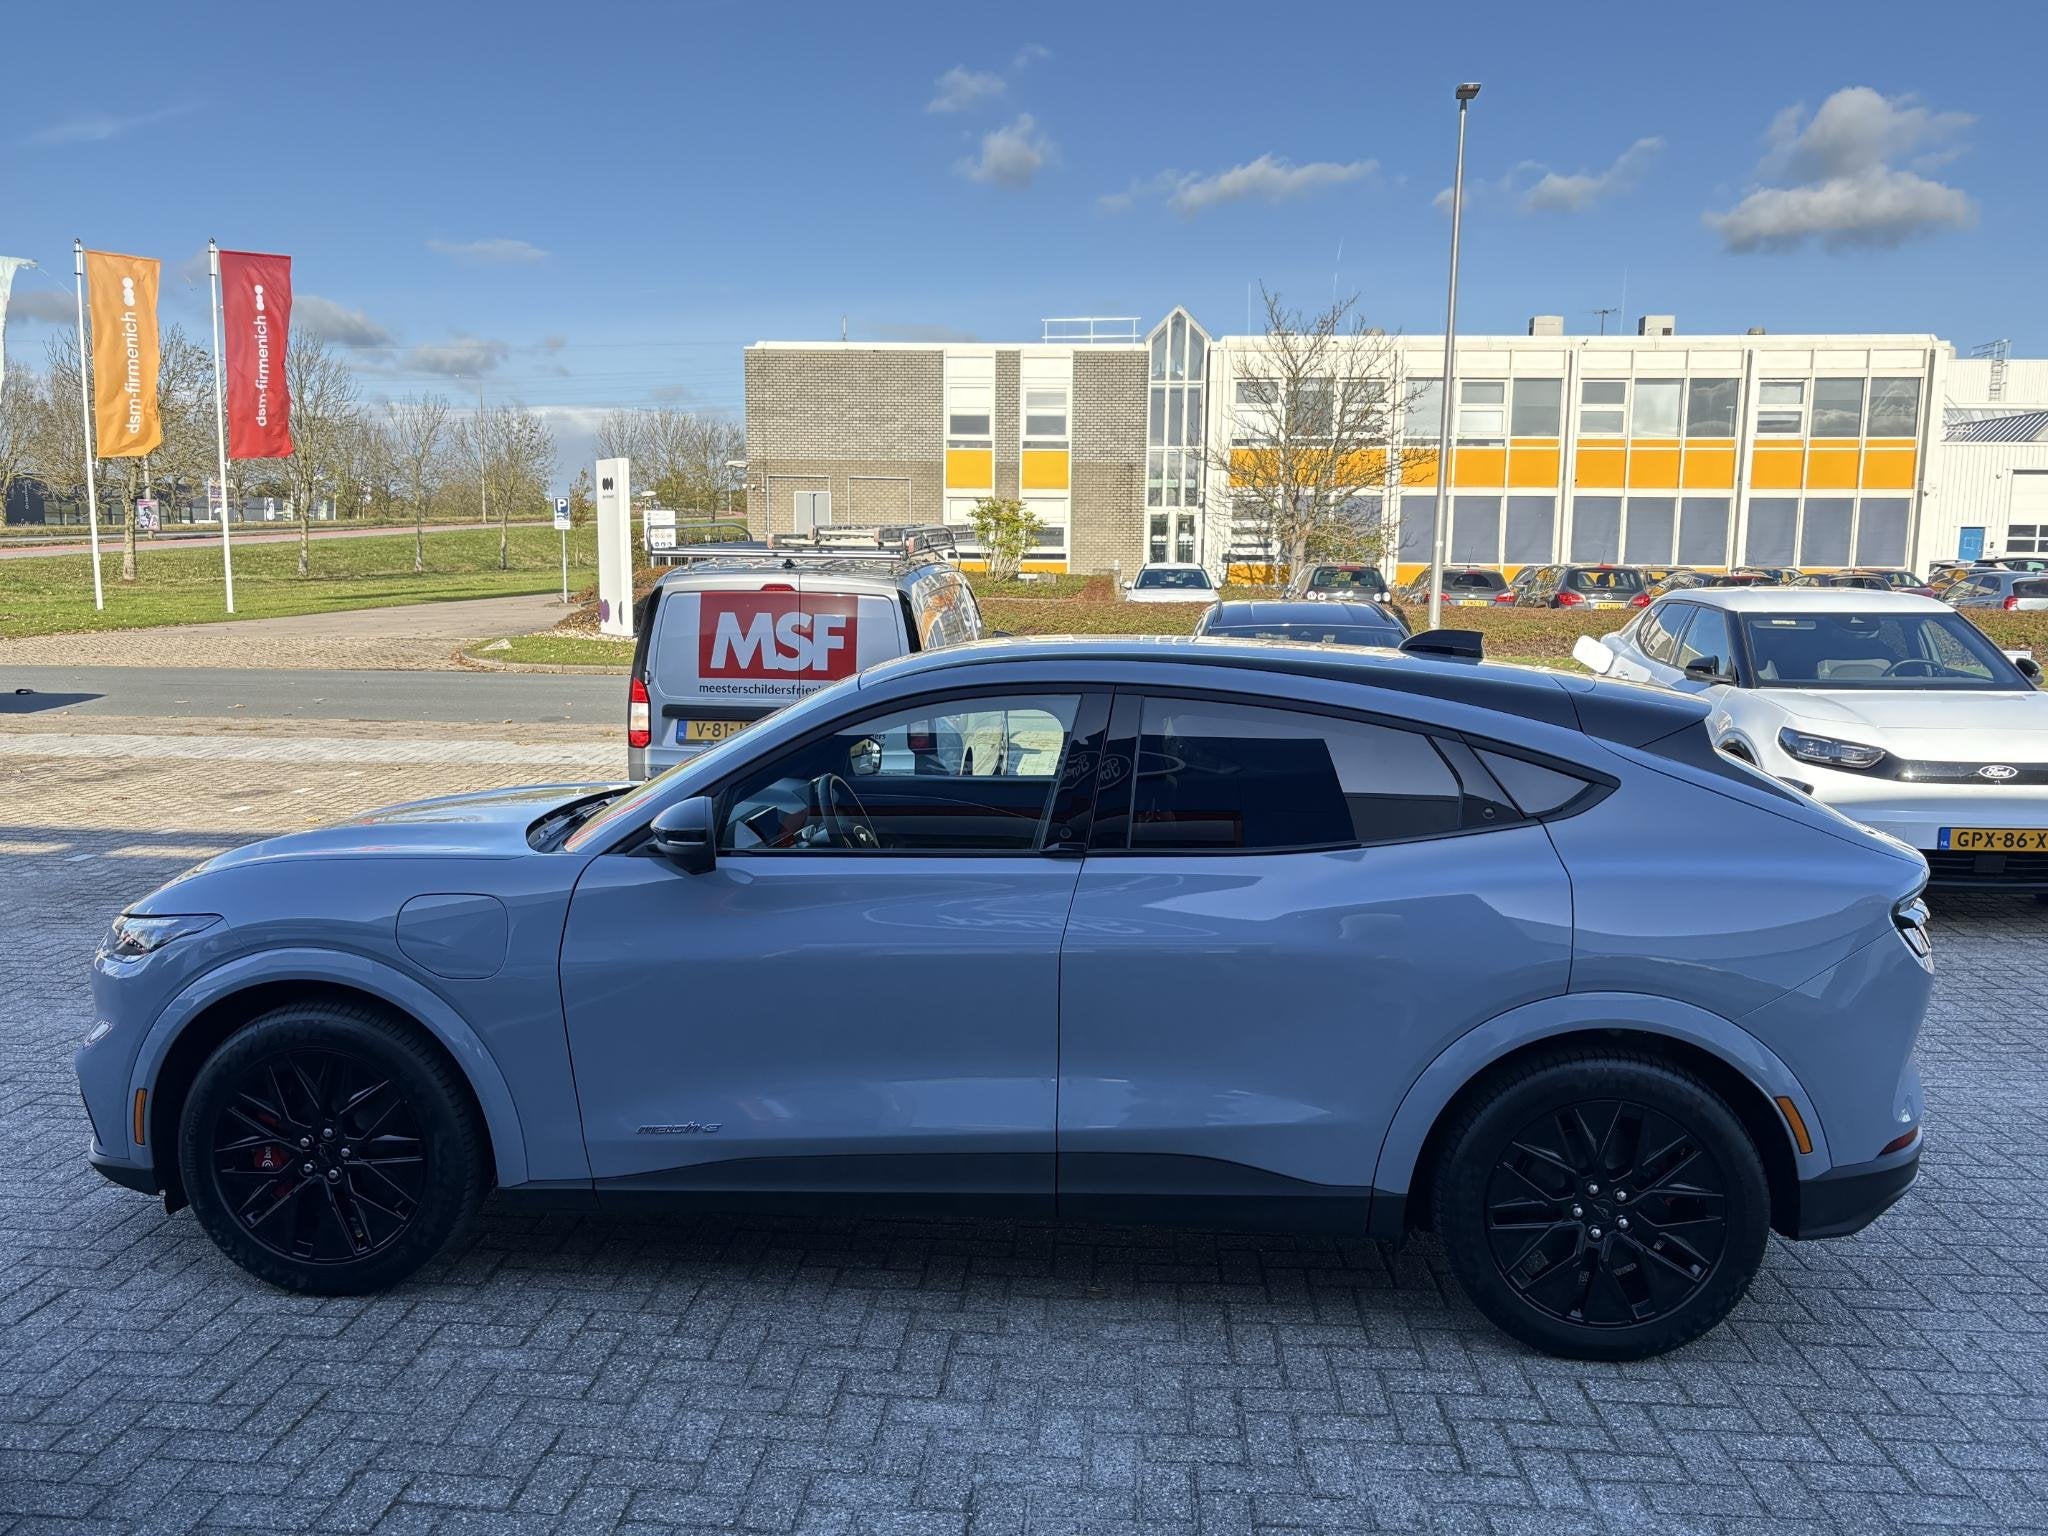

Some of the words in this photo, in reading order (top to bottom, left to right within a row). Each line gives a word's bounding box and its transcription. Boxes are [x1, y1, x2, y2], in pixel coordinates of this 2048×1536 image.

[120, 311, 141, 434] dsm-firmenich
[253, 315, 269, 427] dsm-firmenich
[557, 498, 567, 511] P
[709, 611, 847, 671] MSF
[699, 684, 821, 695] meesterschildersfrie
[1957, 832, 2048, 849] GPX-86-X
